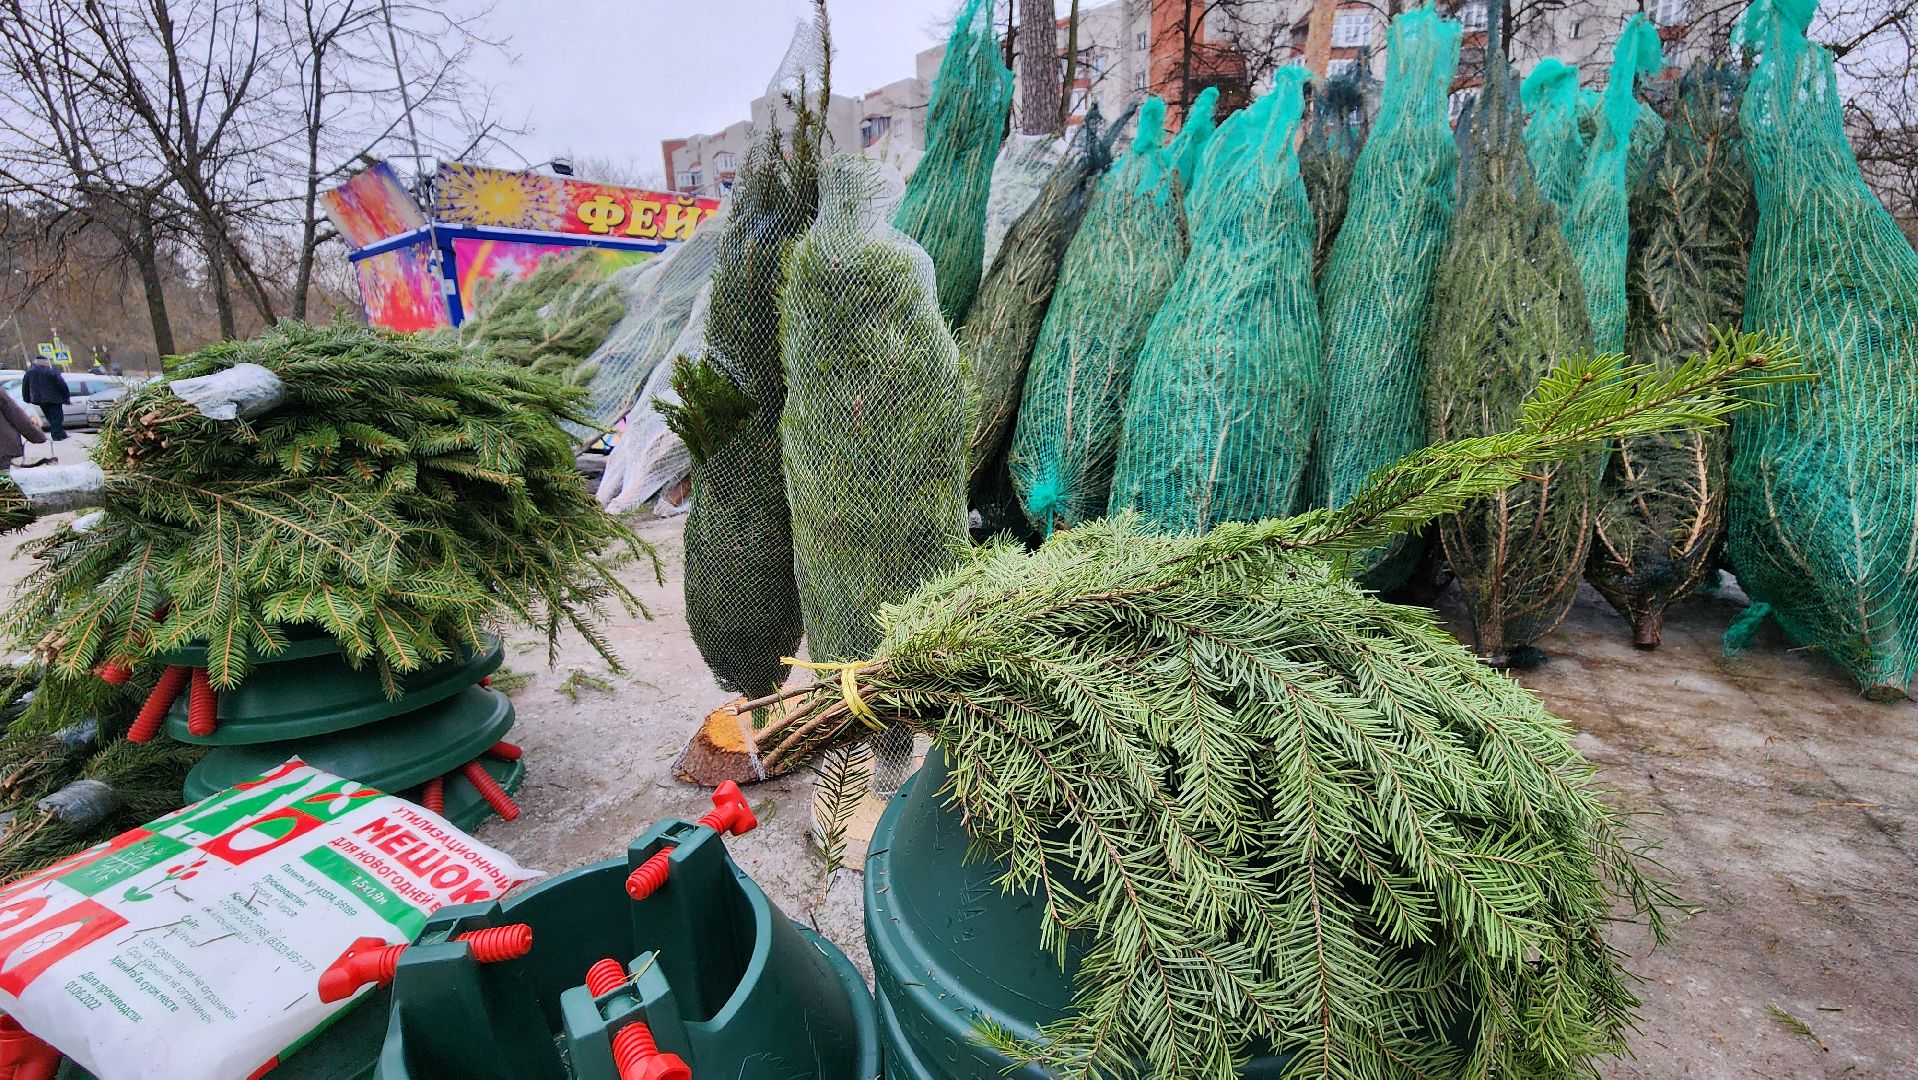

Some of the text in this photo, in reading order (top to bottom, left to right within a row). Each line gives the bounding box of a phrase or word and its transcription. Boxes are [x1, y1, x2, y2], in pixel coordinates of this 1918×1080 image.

[328, 836, 356, 857] ДЛЯ
[354, 849, 436, 904] НОВОГОДНЕЙ
[353, 816, 490, 904] МЕШОК
[393, 806, 511, 889] УТИЛИЗАЦИОННЫЙ
